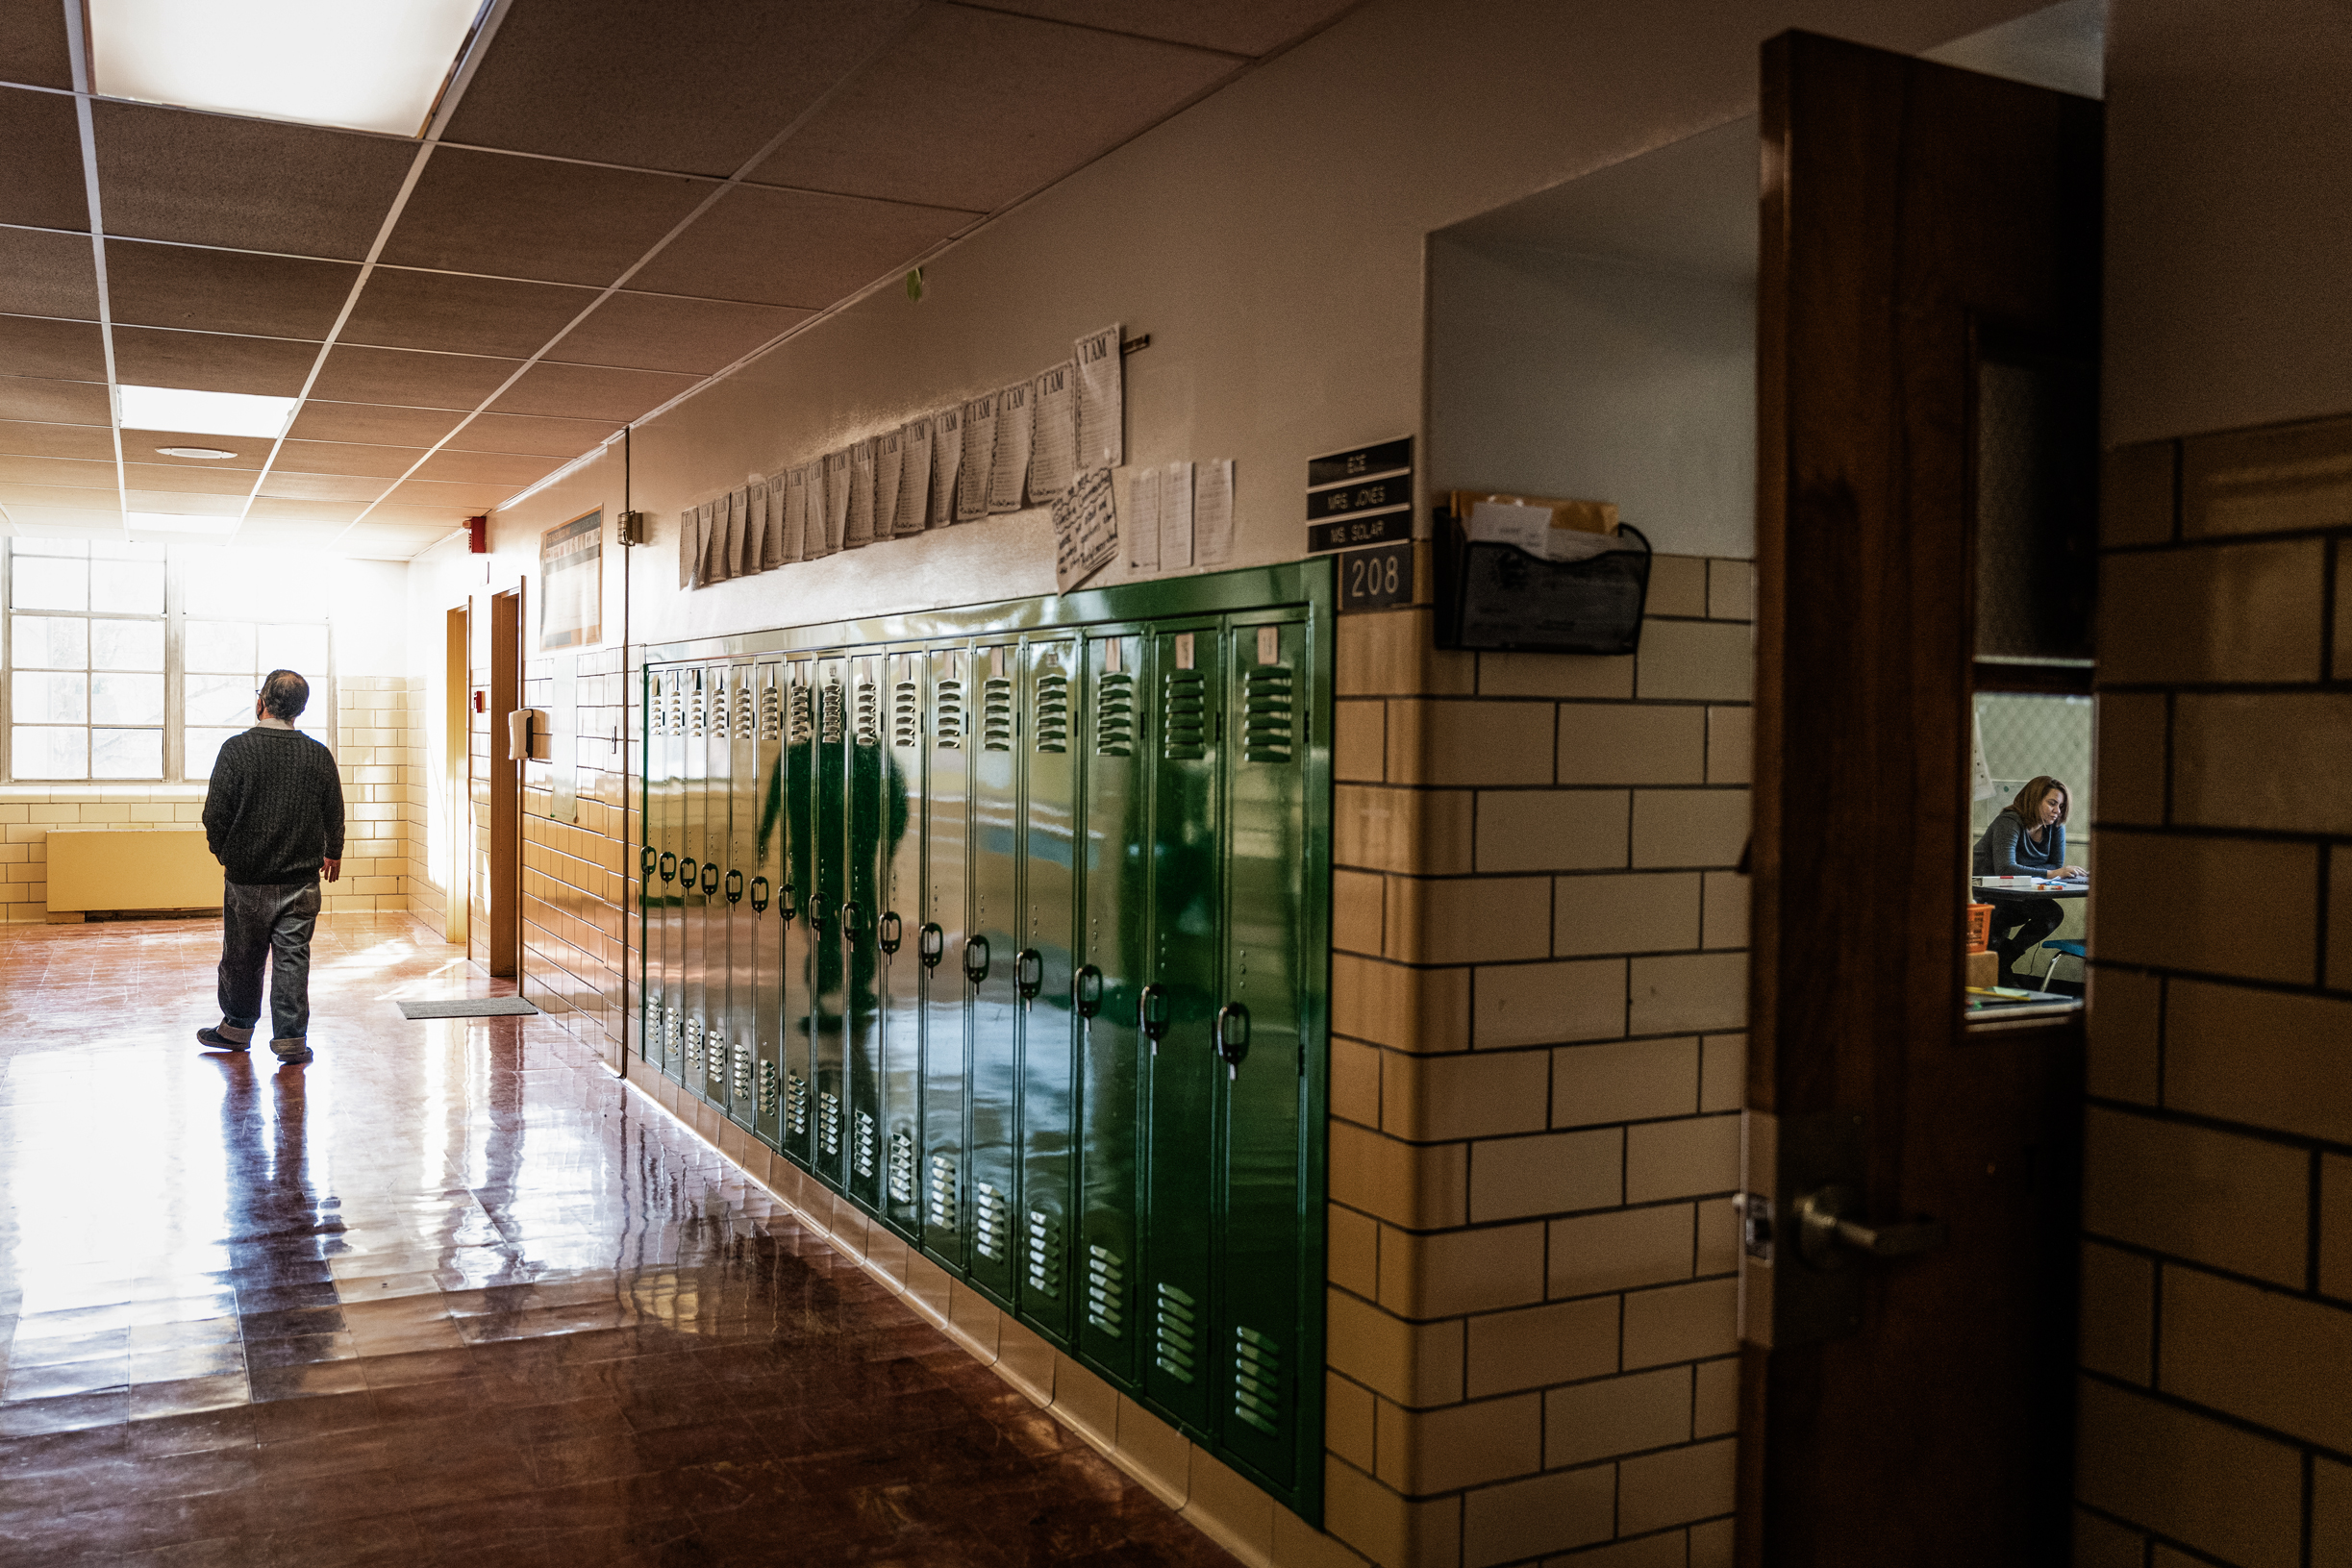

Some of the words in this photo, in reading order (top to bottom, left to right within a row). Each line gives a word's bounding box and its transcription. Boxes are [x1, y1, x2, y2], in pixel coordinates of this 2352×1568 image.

[1090, 336, 1108, 362] AM
[1049, 371, 1063, 394] AM
[1012, 388, 1024, 410] AM
[978, 400, 990, 421] AM
[913, 423, 925, 442] AM
[945, 411, 958, 433] AM
[1330, 526, 1346, 543] MS
[1351, 520, 1385, 541] SOLAR
[1352, 555, 1399, 598] 208
